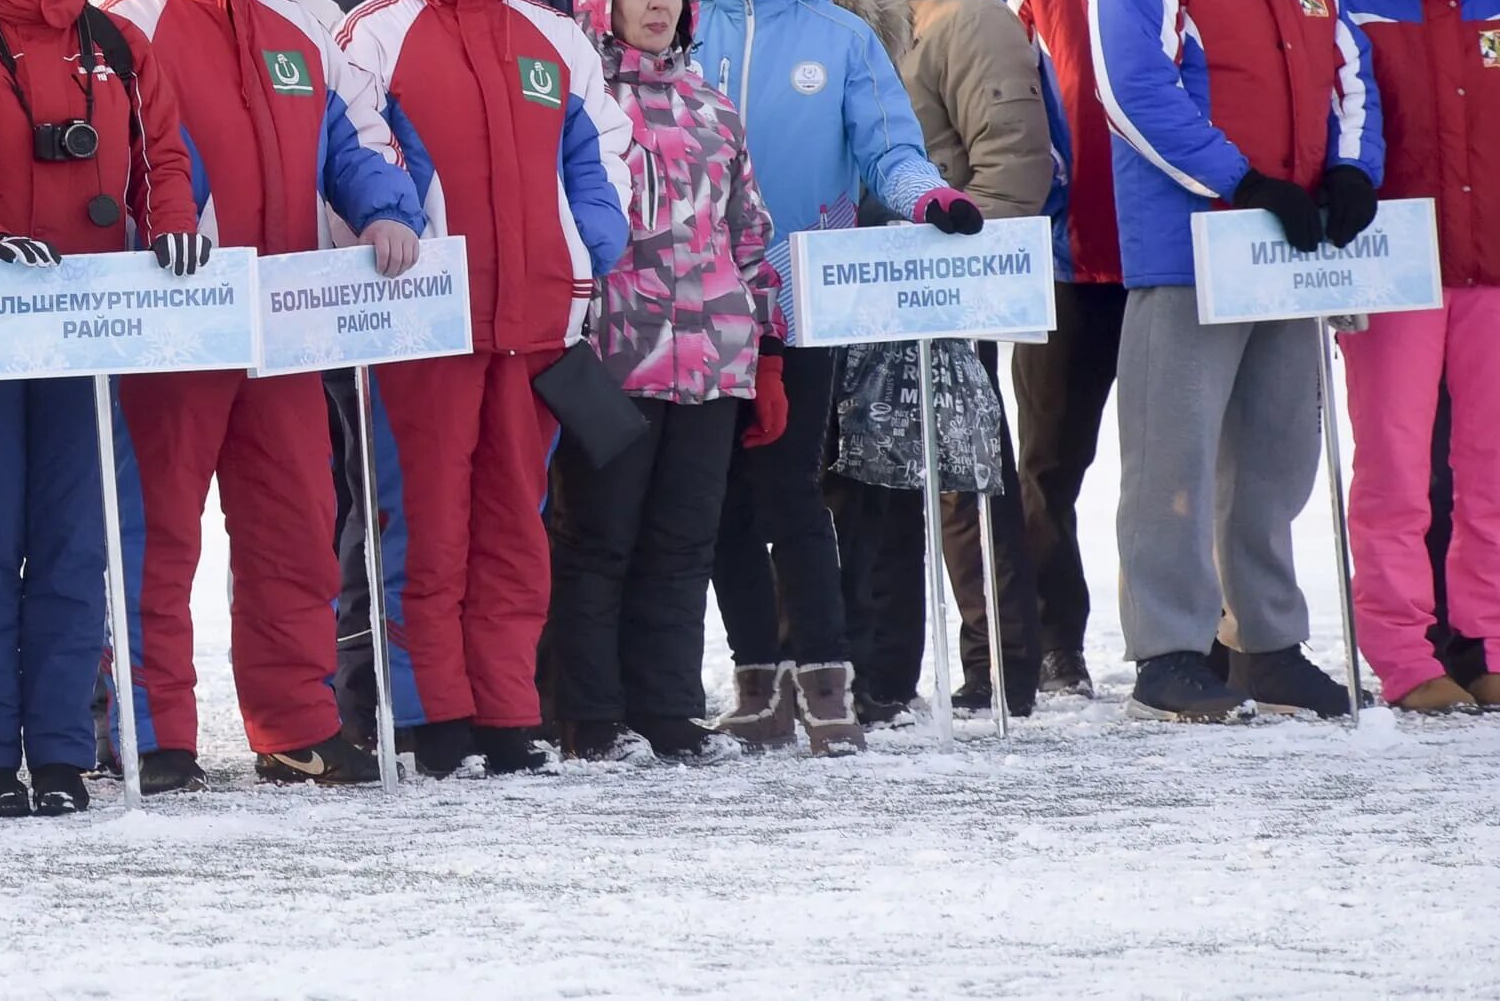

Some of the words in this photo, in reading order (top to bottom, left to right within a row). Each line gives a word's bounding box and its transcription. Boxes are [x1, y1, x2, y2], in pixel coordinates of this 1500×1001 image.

[822, 247, 1031, 286] ЕМЕЛЬЯНОВСКИЙ
[1293, 267, 1353, 290] РАЙОН
[897, 286, 960, 308] РАЙОН
[63, 315, 142, 339] РАЙОН
[336, 310, 392, 334] РАЙОН
